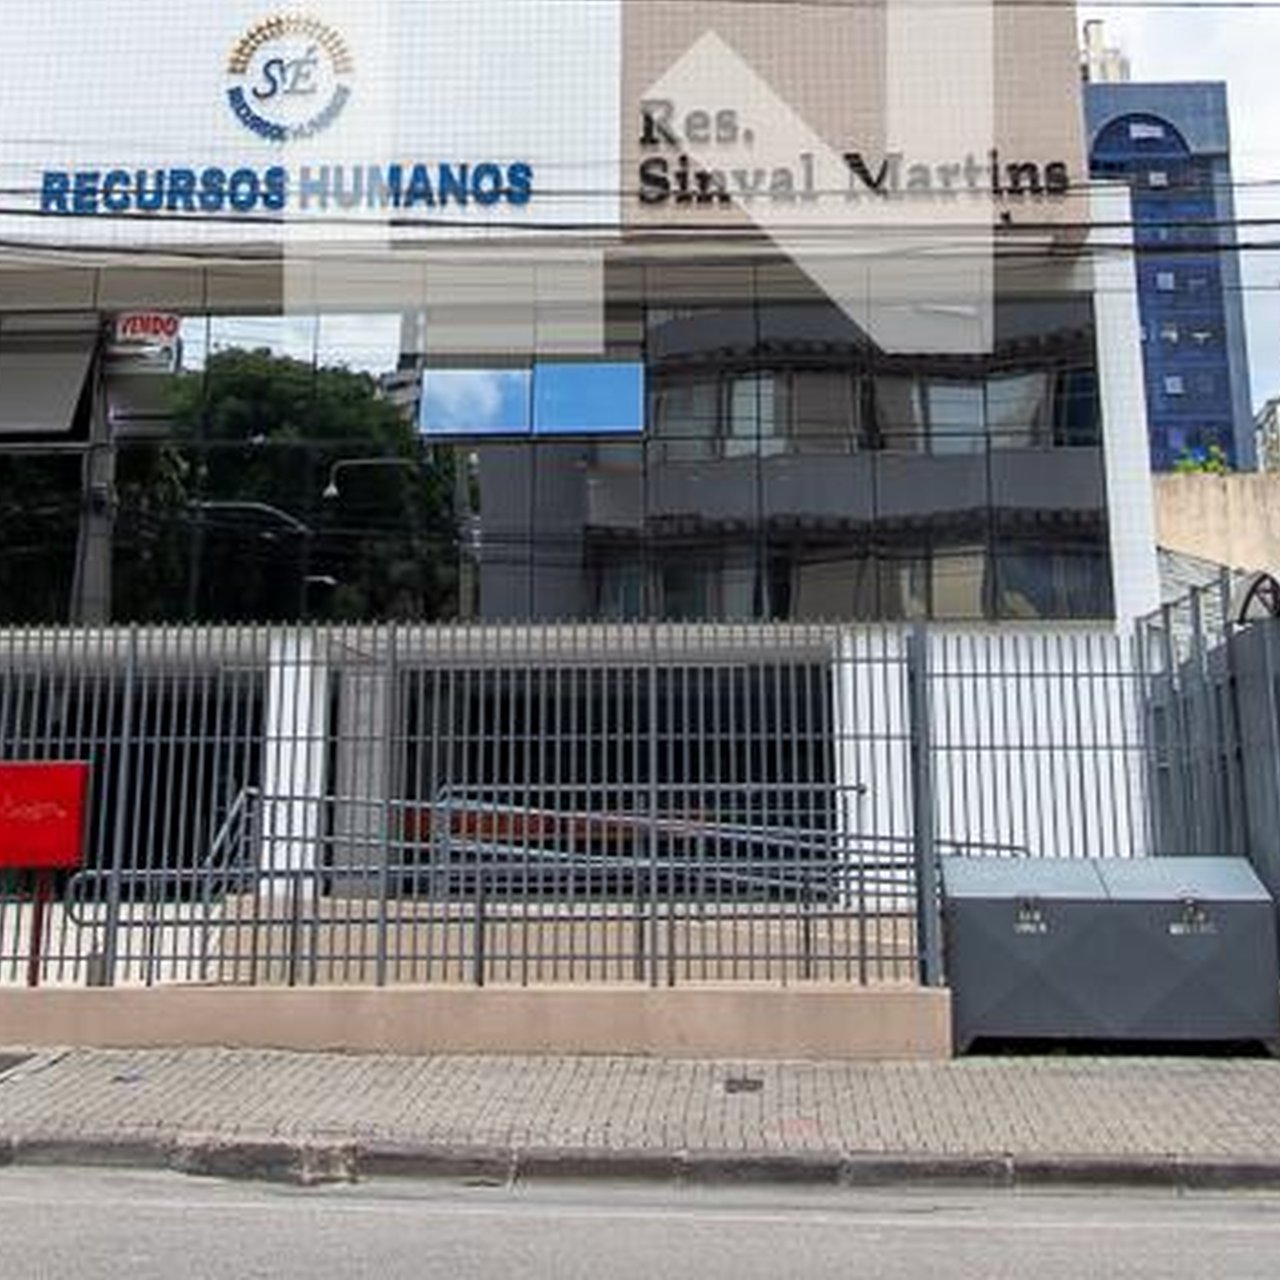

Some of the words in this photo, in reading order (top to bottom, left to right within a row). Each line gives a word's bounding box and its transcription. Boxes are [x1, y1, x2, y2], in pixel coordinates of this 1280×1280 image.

[638, 98, 754, 147] Res.
[41, 166, 287, 213] RECURSOS
[299, 161, 534, 209] HUMANOS
[638, 153, 820, 205] Sinval
[843, 149, 1070, 203] Martins
